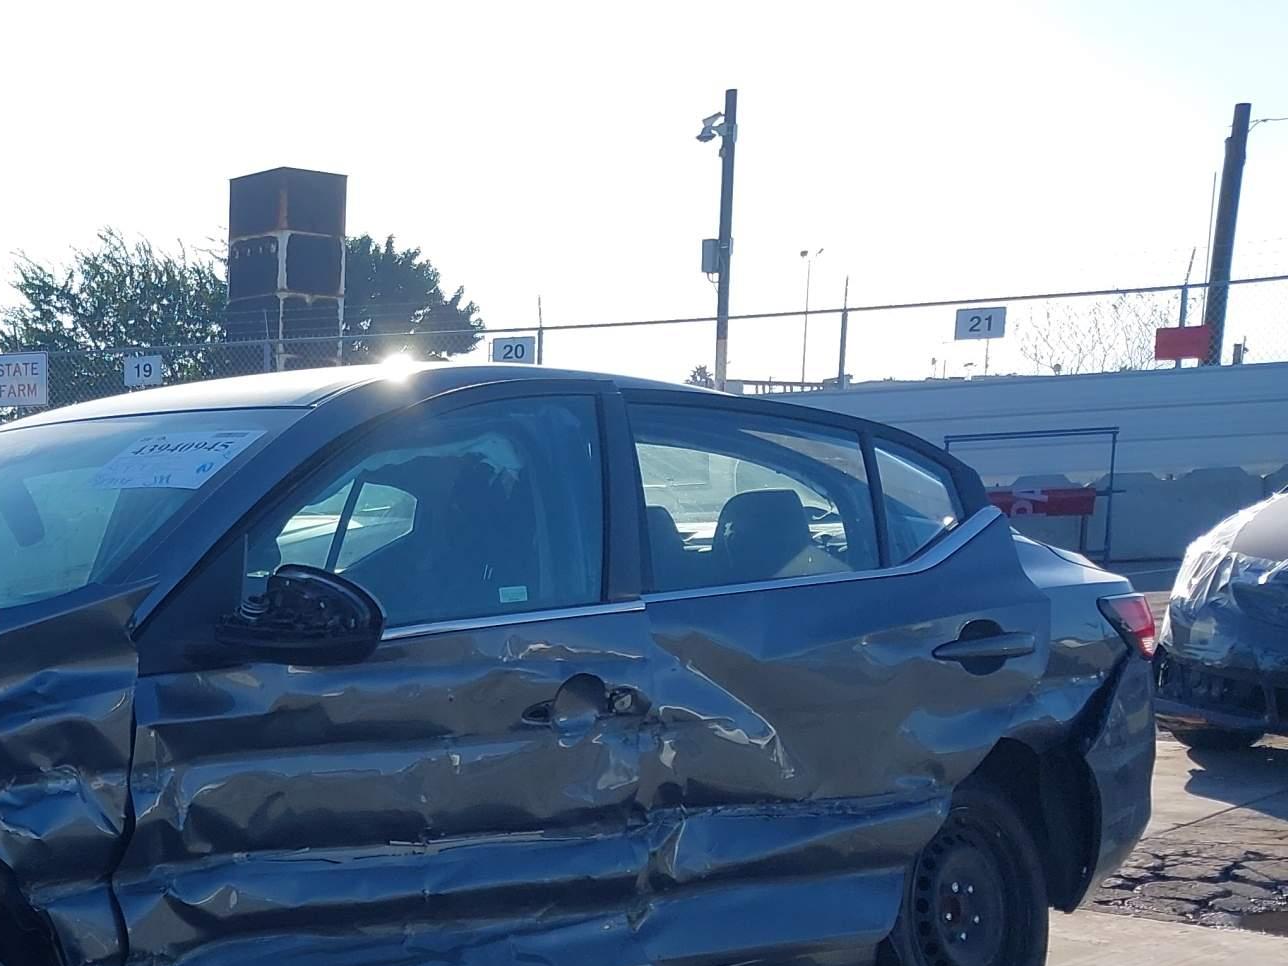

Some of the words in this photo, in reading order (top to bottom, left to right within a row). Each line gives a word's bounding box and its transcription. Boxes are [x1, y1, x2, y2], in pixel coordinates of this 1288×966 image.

[968, 314, 993, 333] 21
[502, 343, 525, 360] 20
[134, 362, 153, 378] 19
[0, 383, 37, 398] FARM
